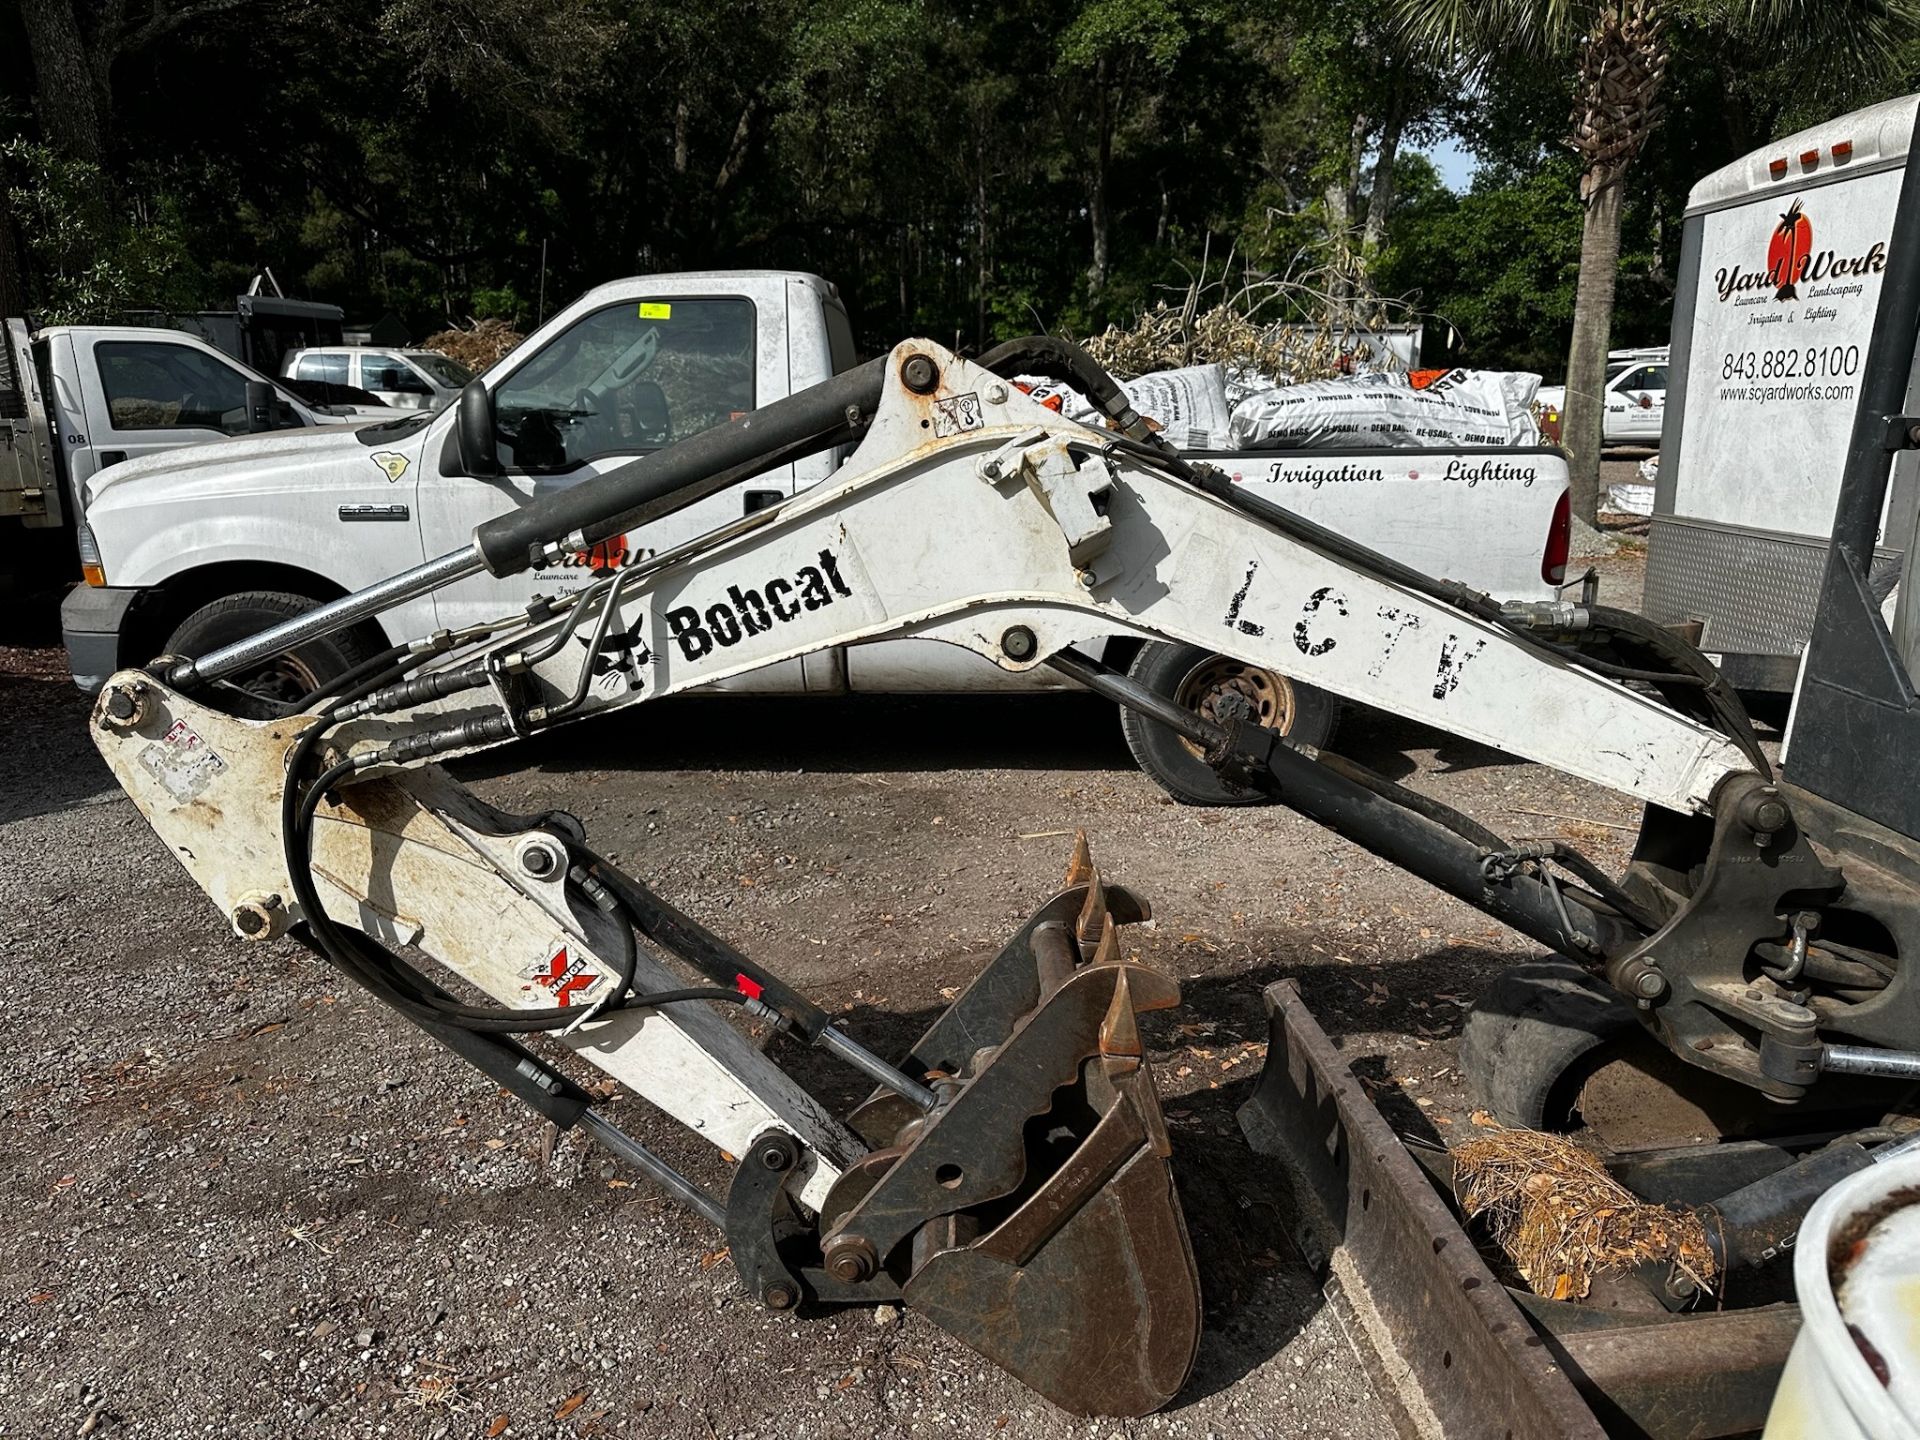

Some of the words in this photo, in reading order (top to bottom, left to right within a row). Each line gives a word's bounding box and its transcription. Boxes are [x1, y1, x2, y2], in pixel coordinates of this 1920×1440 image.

[1715, 258, 1781, 303] Yard
[1733, 295, 1768, 307] Lawncare
[1807, 283, 1863, 299] Landscaping
[1747, 312, 1783, 327] Irrigation
[1787, 311, 1794, 323] &
[1803, 306, 1838, 322] Lighting
[1722, 345, 1859, 380] 843.882.8100
[1720, 382, 1853, 405] www.scyardworks.com
[67, 434, 86, 445] 08
[1268, 428, 1288, 439] DEMO
[1289, 427, 1310, 437] BAGS
[1371, 424, 1391, 433] DEMO
[1464, 434, 1485, 443] DEMO
[1486, 435, 1505, 445] BAGS
[1266, 462, 1384, 489] Irrigation
[1443, 460, 1538, 488] Lighting
[533, 572, 579, 581] Lawncare
[664, 549, 852, 662] Bobcat
